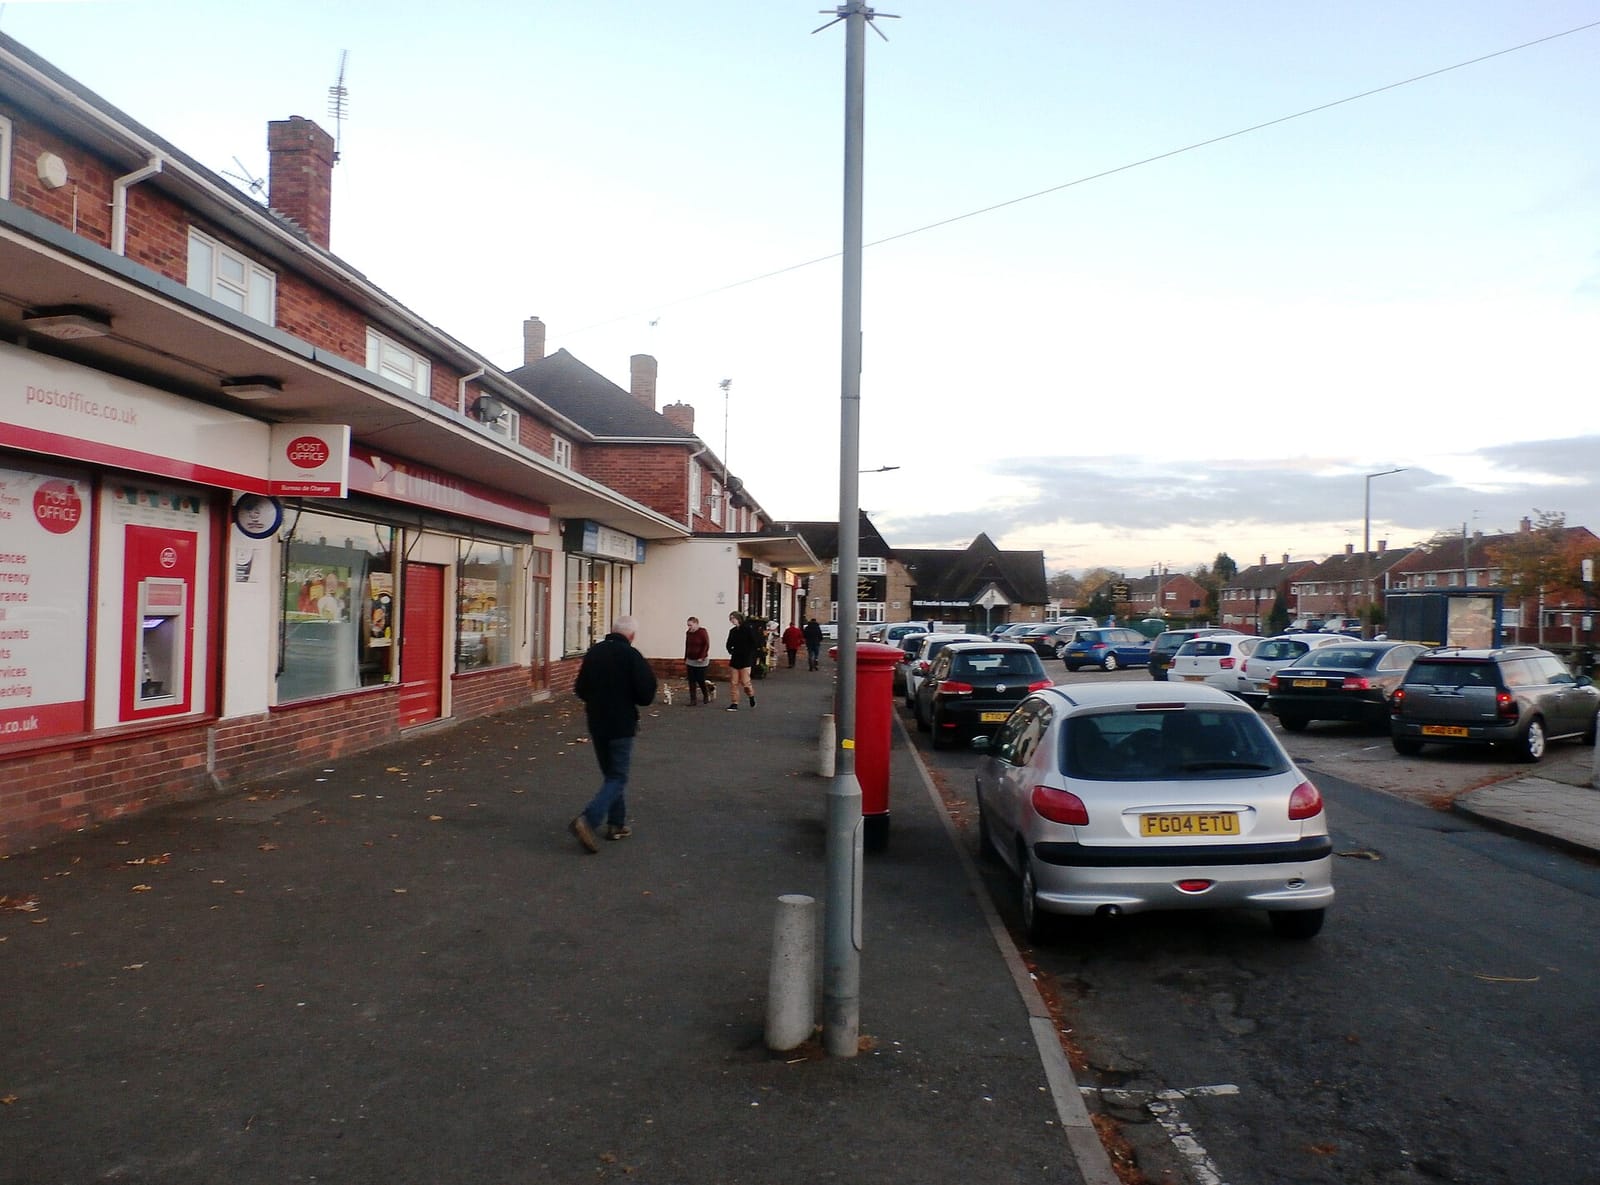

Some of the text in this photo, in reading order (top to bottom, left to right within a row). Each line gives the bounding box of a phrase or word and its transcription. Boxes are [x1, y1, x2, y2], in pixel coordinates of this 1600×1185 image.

[26, 386, 137, 424] postoffice.co.uk
[296, 442, 321, 452] POST
[290, 452, 325, 461] OFFICE
[44, 491, 73, 505] POST
[37, 505, 77, 521] OFFICE
[1147, 815, 1233, 832] FG04 ETU
